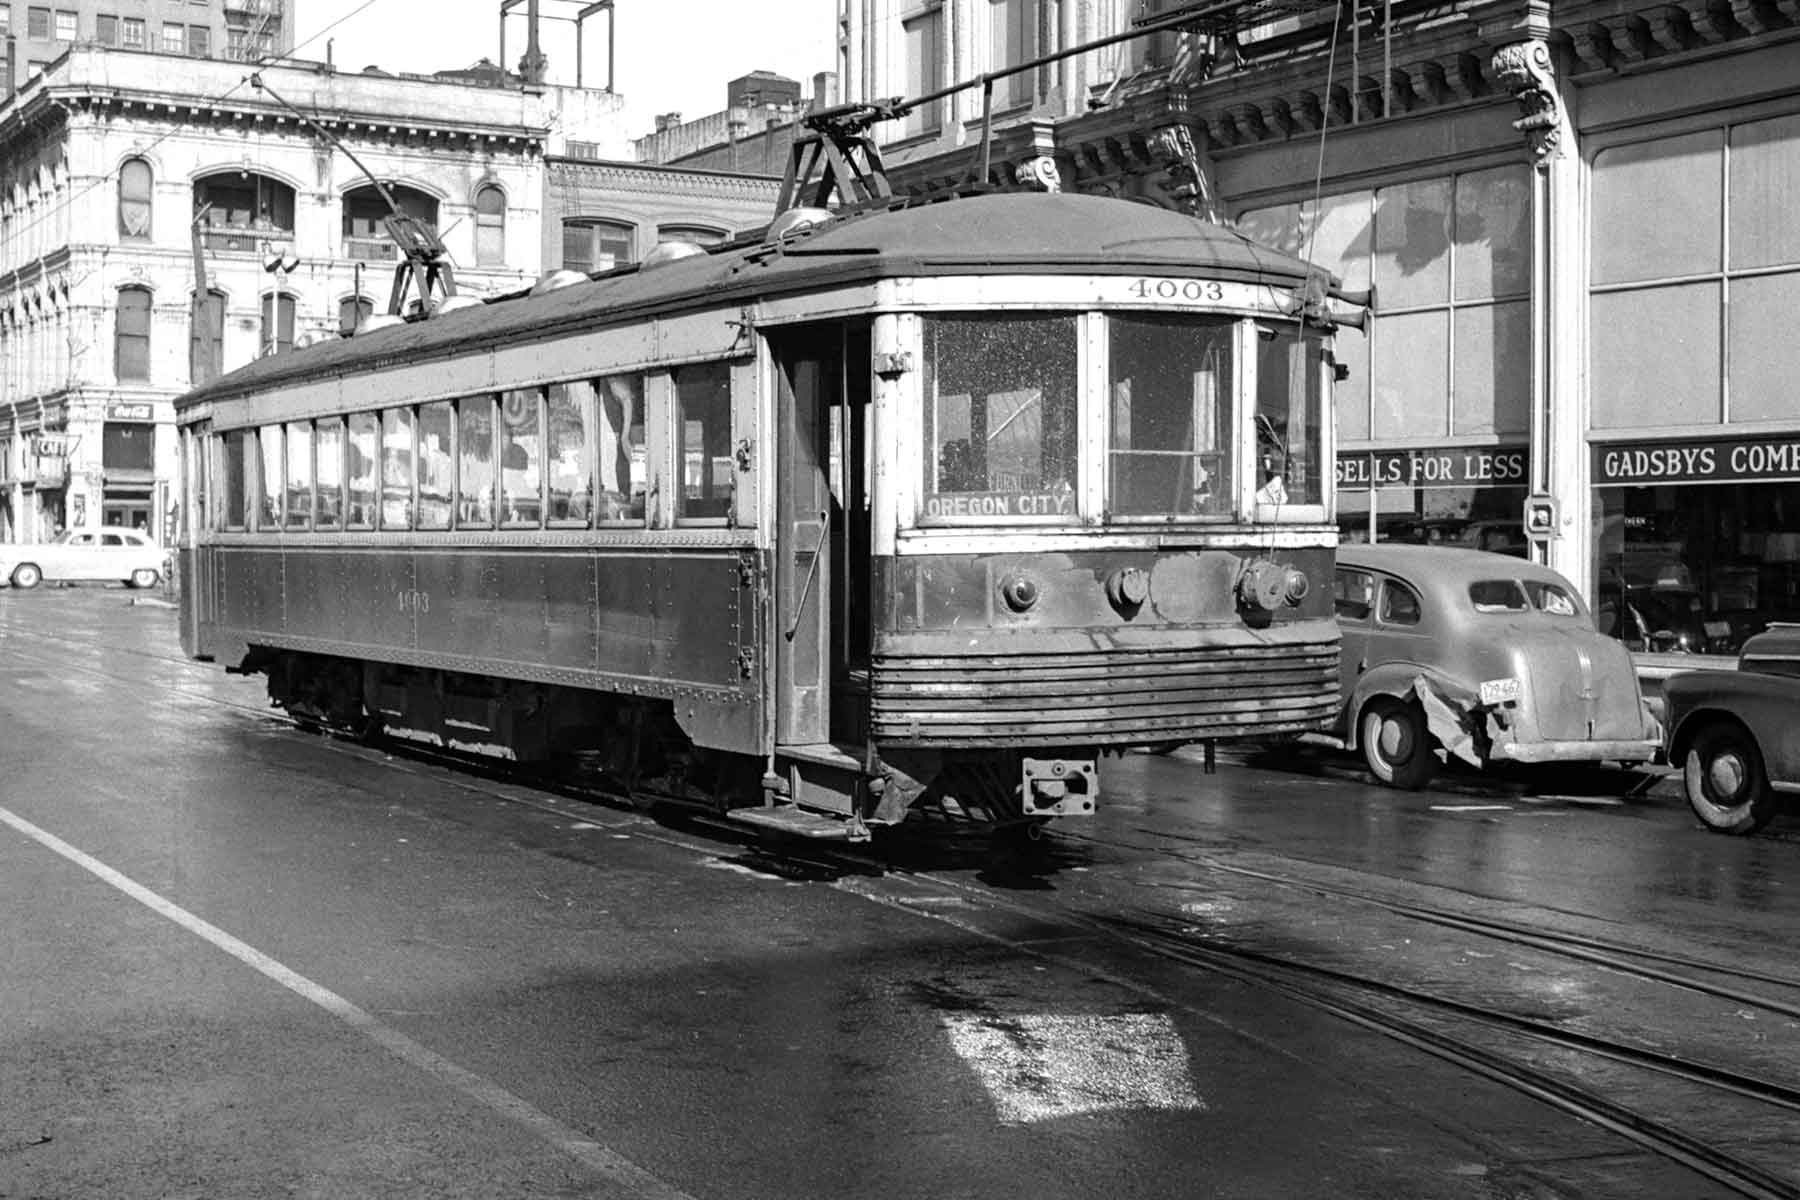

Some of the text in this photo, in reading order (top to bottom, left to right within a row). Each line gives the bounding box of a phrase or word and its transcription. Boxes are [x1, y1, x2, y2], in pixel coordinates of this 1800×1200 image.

[1128, 279, 1223, 301] 4003
[1336, 455, 1522, 482] SELLS FOR LESS
[1605, 448, 1716, 477] GADSBYS
[928, 494, 1067, 517] OREGON CITY
